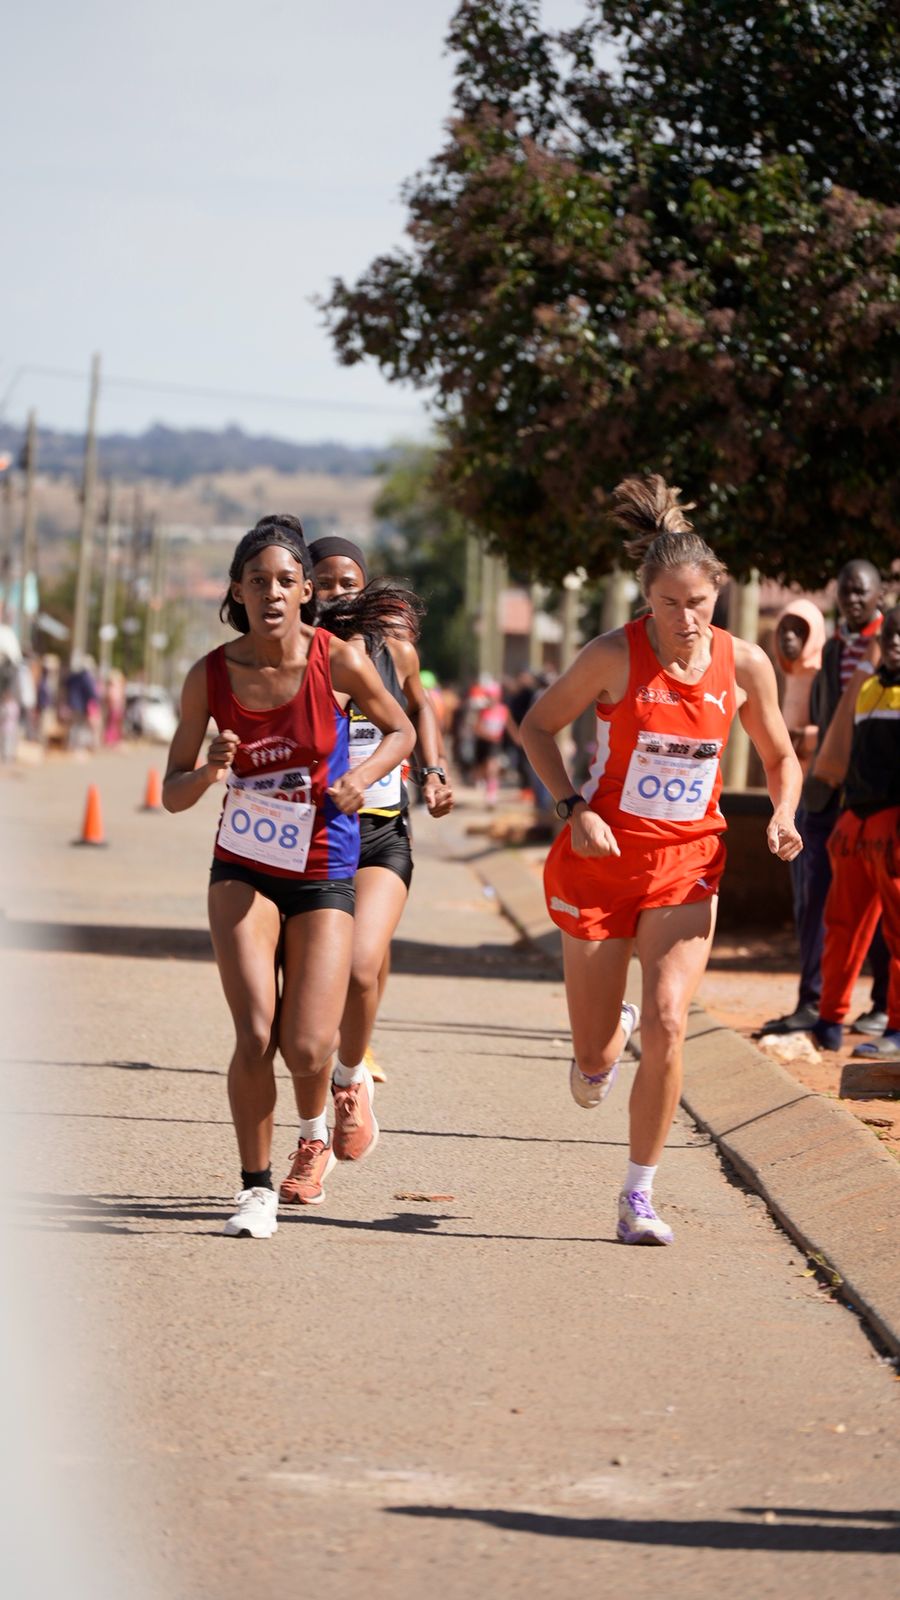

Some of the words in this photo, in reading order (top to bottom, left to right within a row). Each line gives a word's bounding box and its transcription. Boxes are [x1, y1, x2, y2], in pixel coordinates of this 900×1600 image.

[354, 728, 376, 739] 2026
[667, 743, 691, 754] 2026
[638, 775, 703, 803] 005
[231, 808, 299, 849] 008
